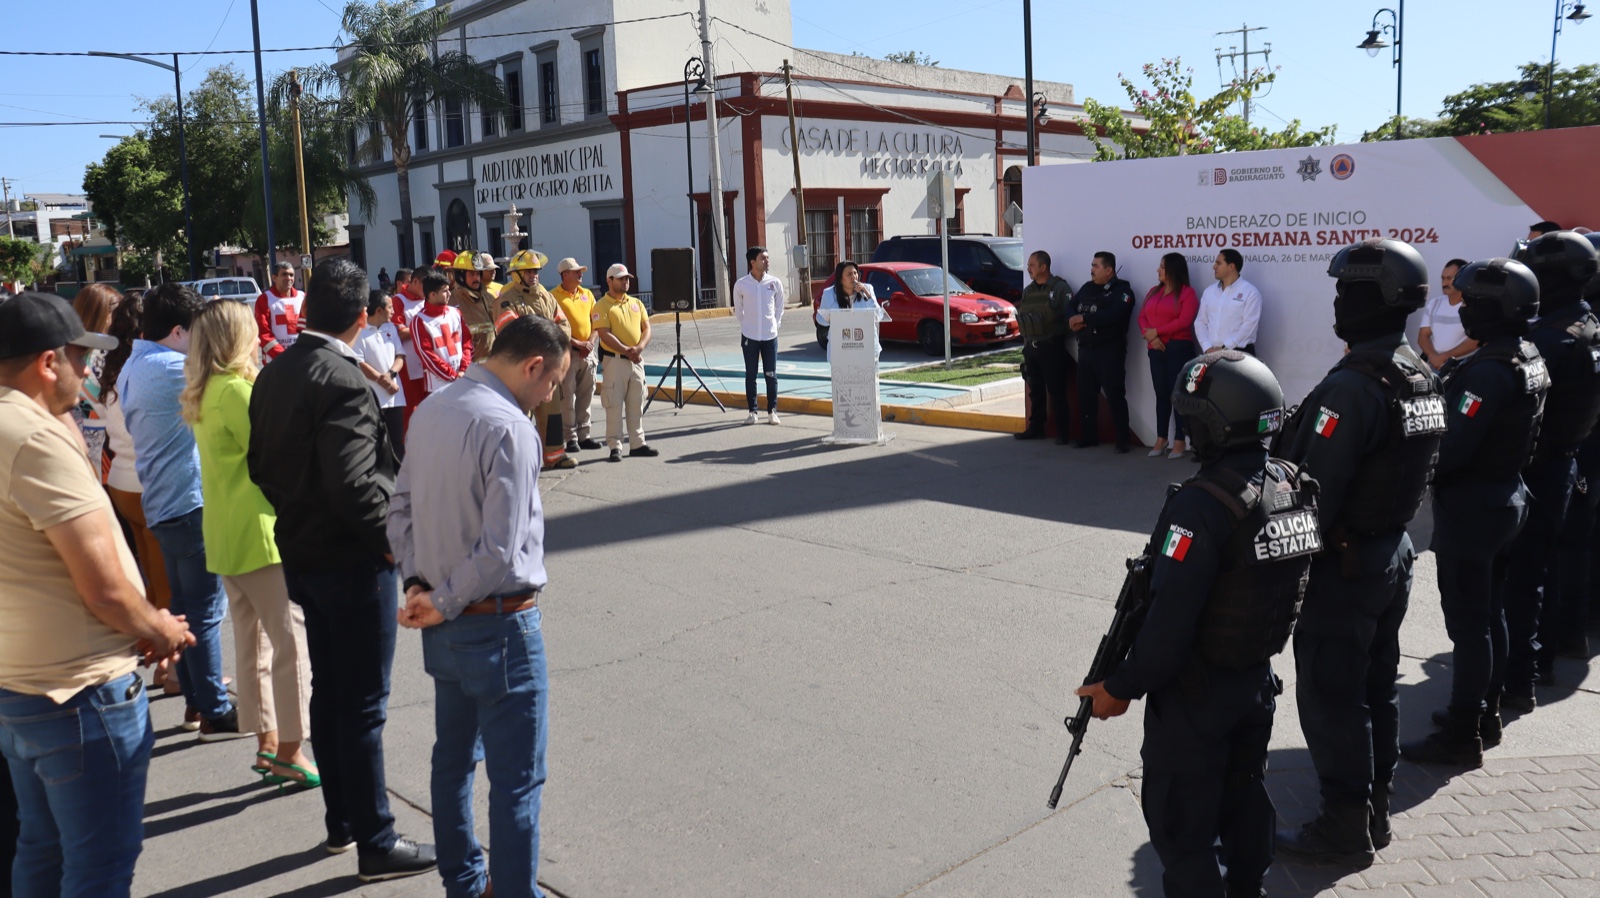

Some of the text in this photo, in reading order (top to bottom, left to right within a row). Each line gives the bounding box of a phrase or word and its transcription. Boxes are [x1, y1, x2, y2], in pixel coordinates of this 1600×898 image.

[782, 127, 963, 154] CASA DE LA CULTURA
[482, 144, 607, 183] AUDITORIO MUNICIPAL
[1230, 167, 1271, 175] GOBIERNO
[1229, 173, 1286, 182] BADIRAGUATO
[477, 174, 613, 204] DR HECTOR CASTRO ABITIA
[1186, 210, 1367, 230] BANDERAZO DE INICIO
[1131, 233, 1228, 249] OPERATIVO
[1231, 231, 1312, 247] SEMANA
[1388, 227, 1440, 244] 2024
[1243, 254, 1279, 264] INALOA,
[1281, 254, 1292, 262] 26
[1294, 253, 1307, 262] DE
[1254, 532, 1318, 560] ESTATAL
